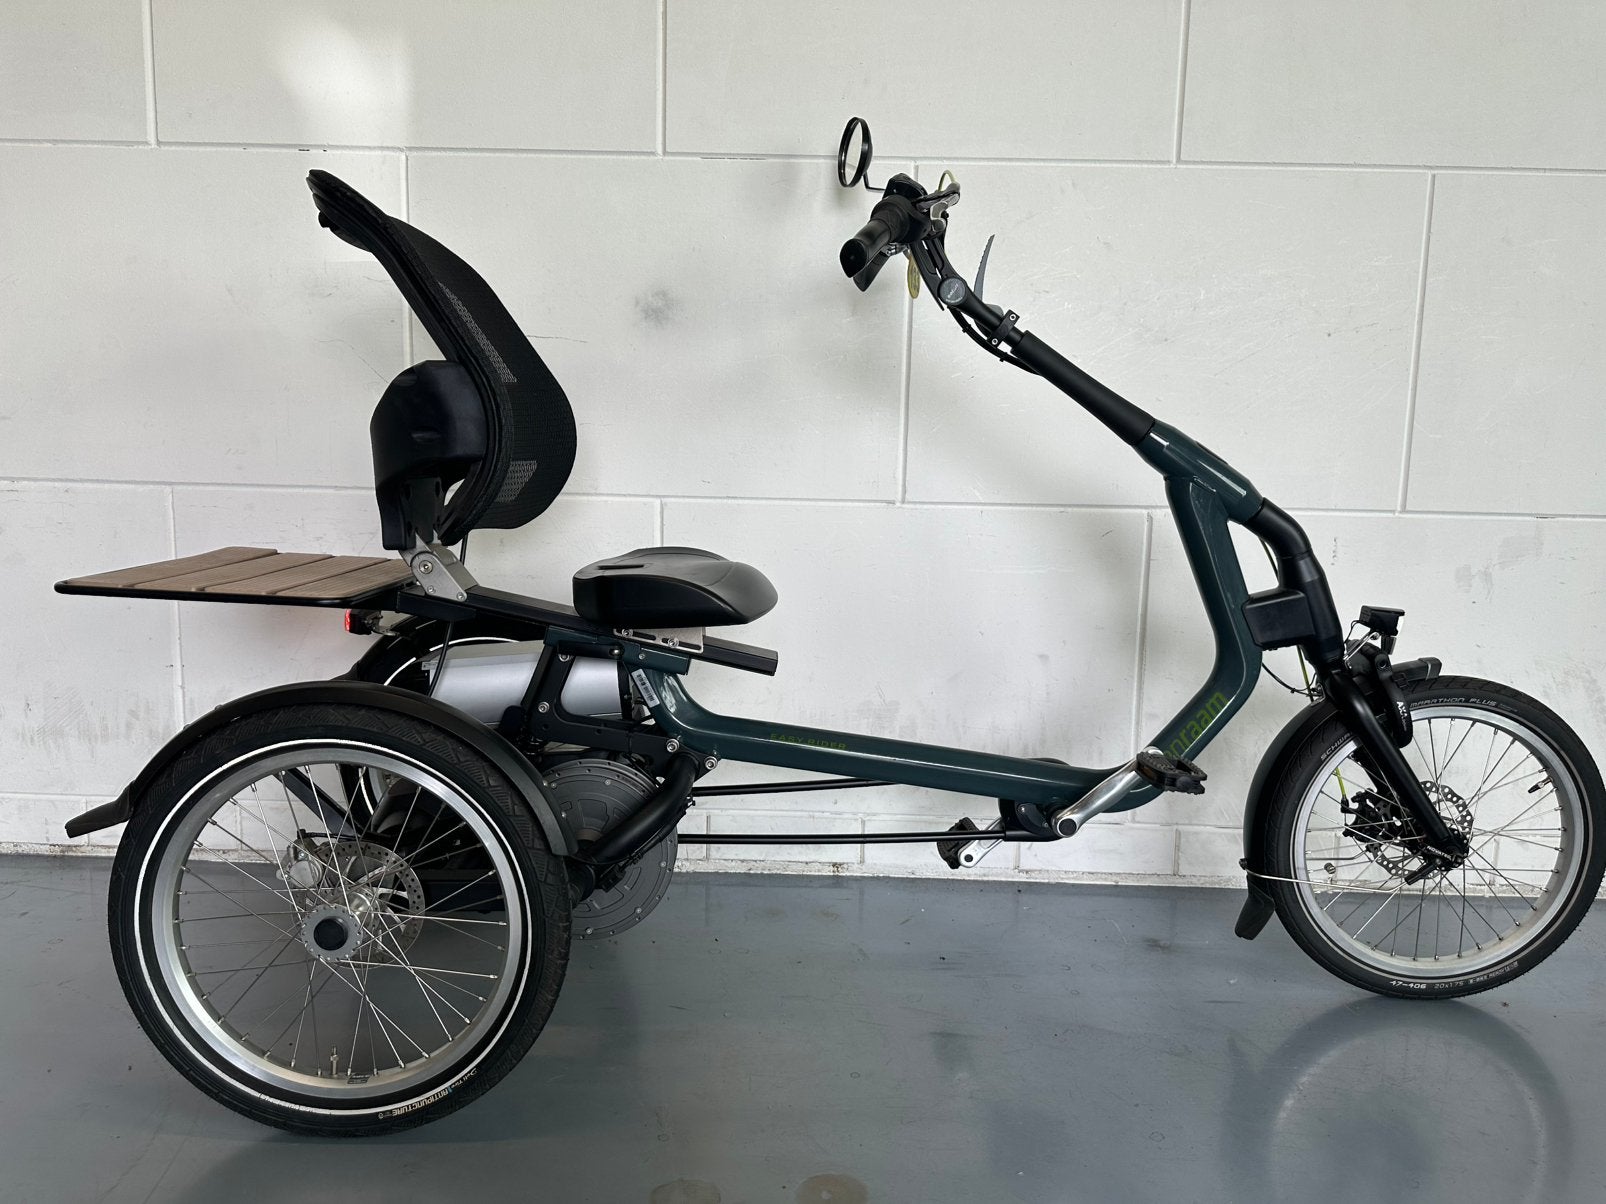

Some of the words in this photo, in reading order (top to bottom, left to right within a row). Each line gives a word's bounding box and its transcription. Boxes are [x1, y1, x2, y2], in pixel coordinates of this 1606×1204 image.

[1396, 701, 1408, 718] AXA
[1410, 697, 1465, 708] MARATHON
[1469, 697, 1497, 707] PLUS
[770, 733, 804, 743] EASY
[807, 738, 848, 750] RIDER
[1320, 731, 1352, 761] SCHWA
[1389, 980, 1427, 989] 47-406
[391, 1088, 449, 1117] ANTIPUNCTURE
